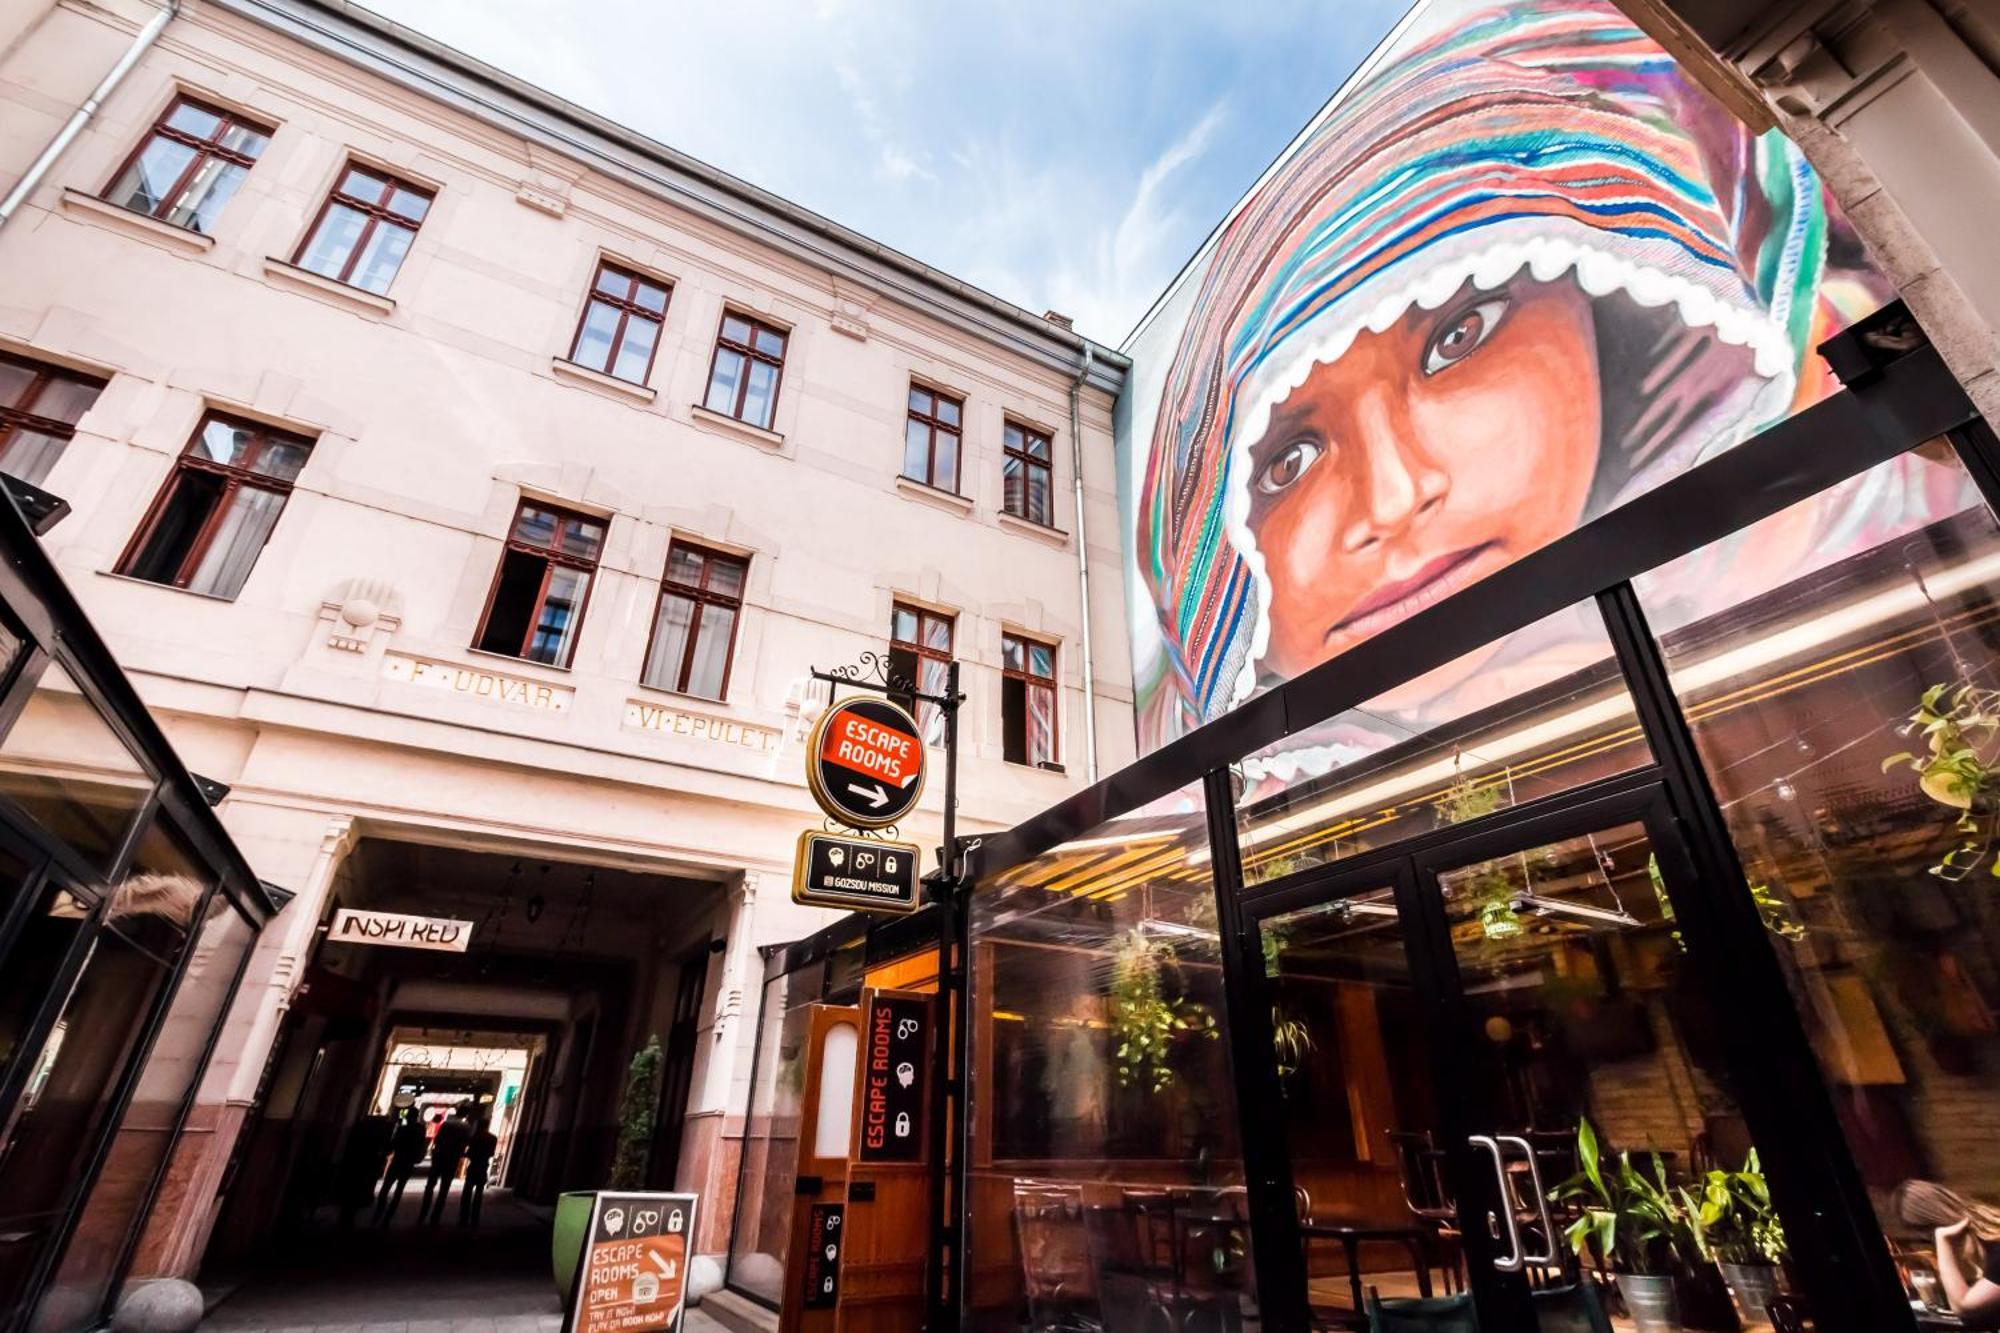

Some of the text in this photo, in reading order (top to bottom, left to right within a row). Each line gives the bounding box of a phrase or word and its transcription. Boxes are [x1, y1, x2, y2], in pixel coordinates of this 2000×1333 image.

[846, 720, 911, 759] ESCAPE
[838, 740, 901, 778] ROOMS
[868, 881, 899, 895] MISSION
[867, 1007, 892, 1149] ESCAPE ROOMS
[592, 1244, 644, 1265] ESCAPE
[590, 1264, 640, 1285] ROOMS
[590, 1287, 618, 1304] OPEN
